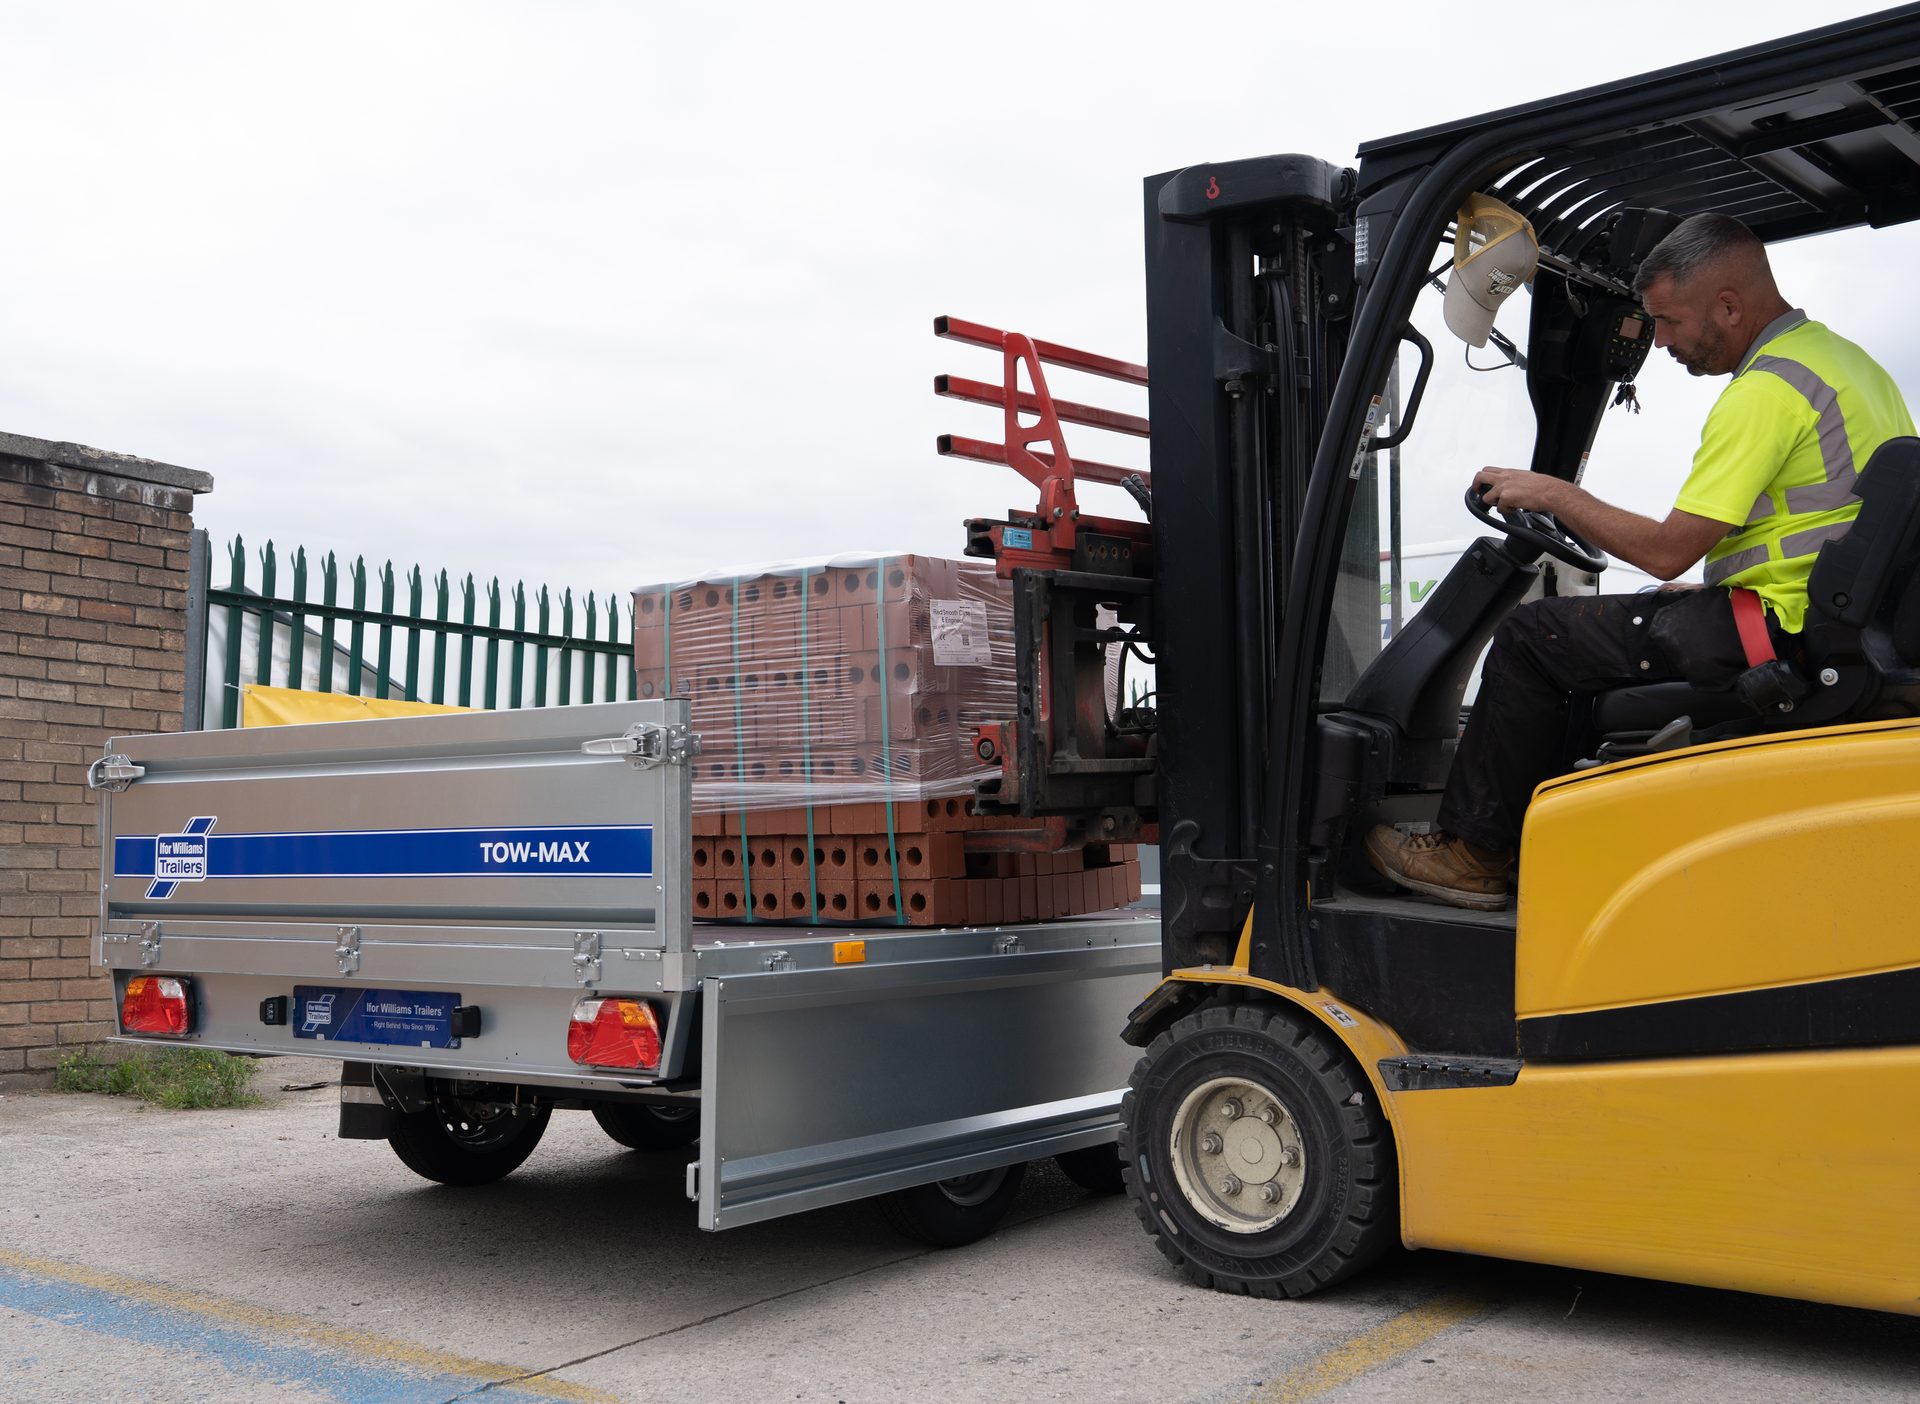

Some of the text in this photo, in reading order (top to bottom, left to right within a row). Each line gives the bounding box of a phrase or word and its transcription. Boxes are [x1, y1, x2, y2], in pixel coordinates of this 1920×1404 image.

[159, 842, 204, 855] Ifor Williams
[479, 841, 590, 863] TOW-MAX
[159, 859, 203, 874] Trailers
[315, 1004, 330, 1012] Williams
[366, 1002, 442, 1016] Ifor Williams Trailers
[308, 1012, 329, 1021] Trailers
[374, 1021, 385, 1030] Right
[386, 1021, 401, 1030] Behind
[402, 1022, 411, 1030] You
[411, 1023, 424, 1031] Since
